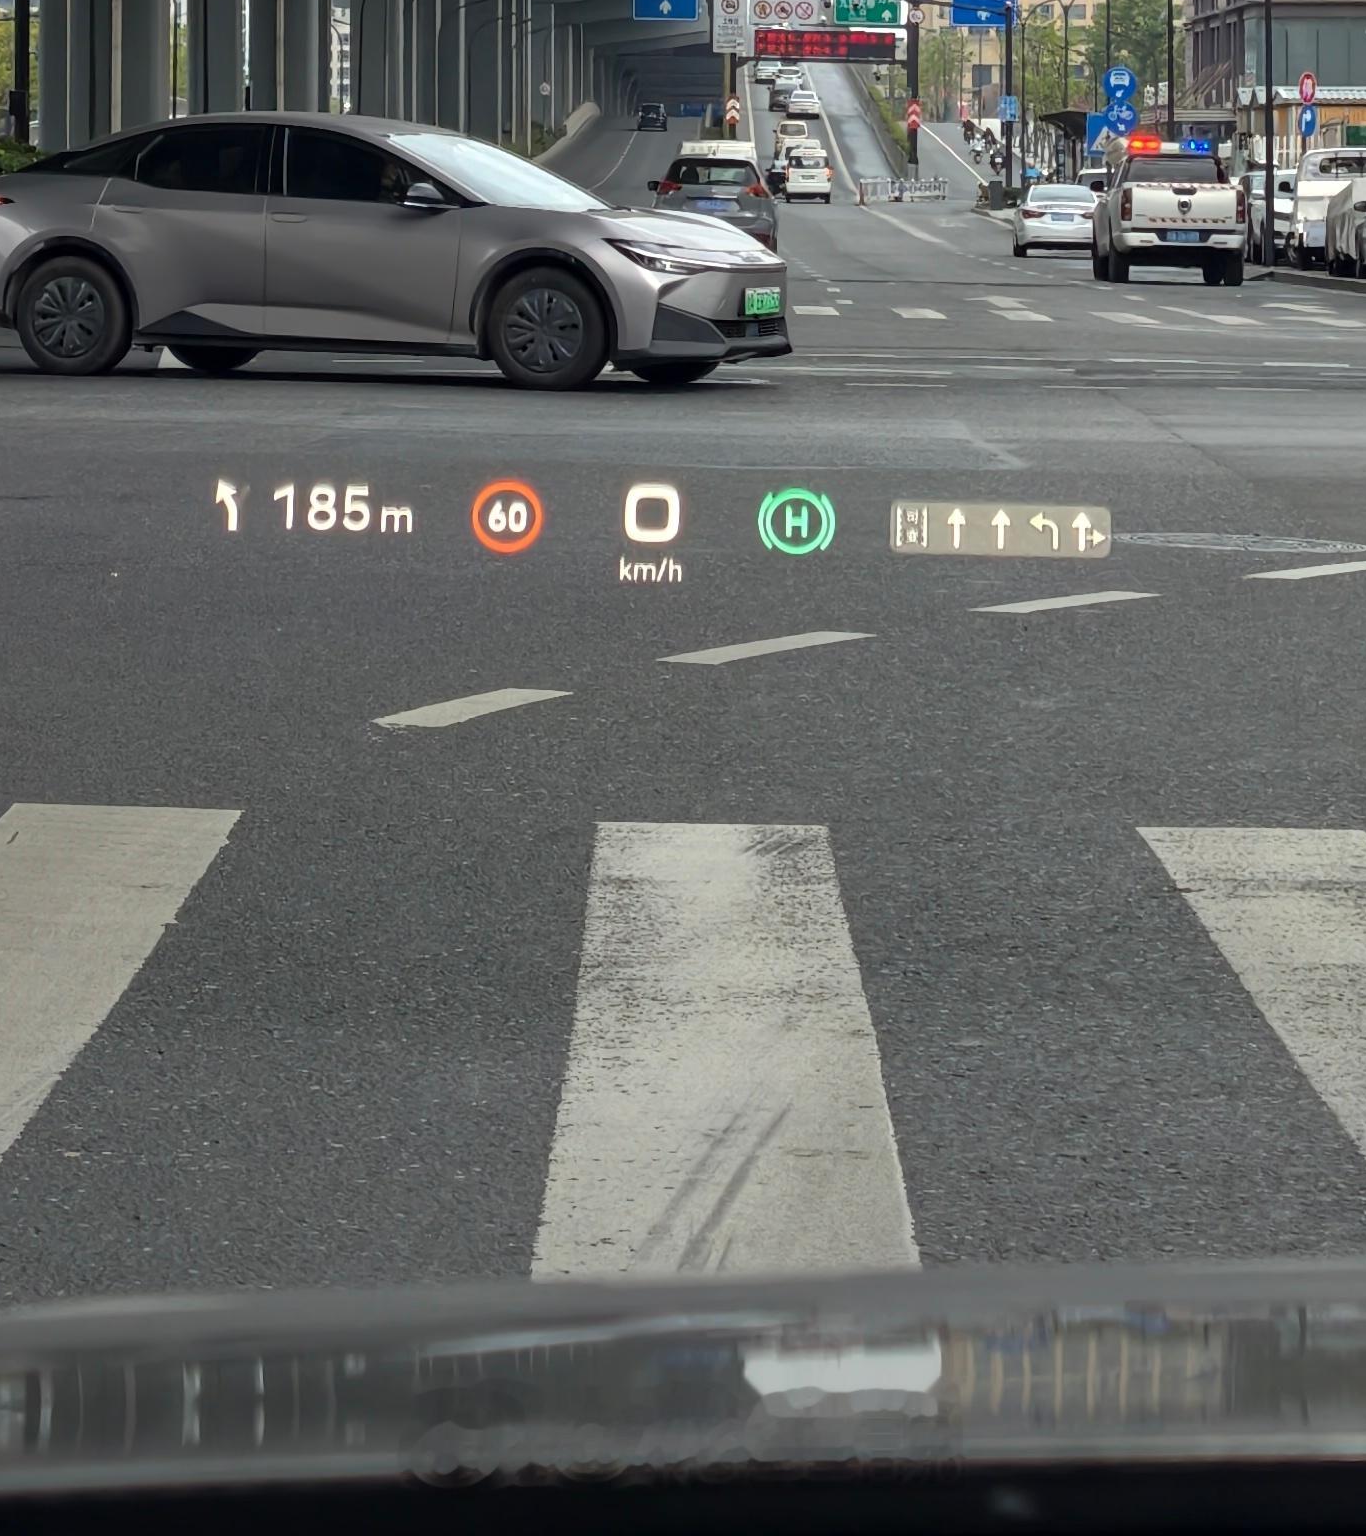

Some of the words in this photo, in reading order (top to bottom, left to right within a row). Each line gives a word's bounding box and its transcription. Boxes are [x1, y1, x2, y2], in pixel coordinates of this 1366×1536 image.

[487, 499, 528, 533] 60
[624, 483, 681, 543] 0
[619, 555, 683, 584] km/h
